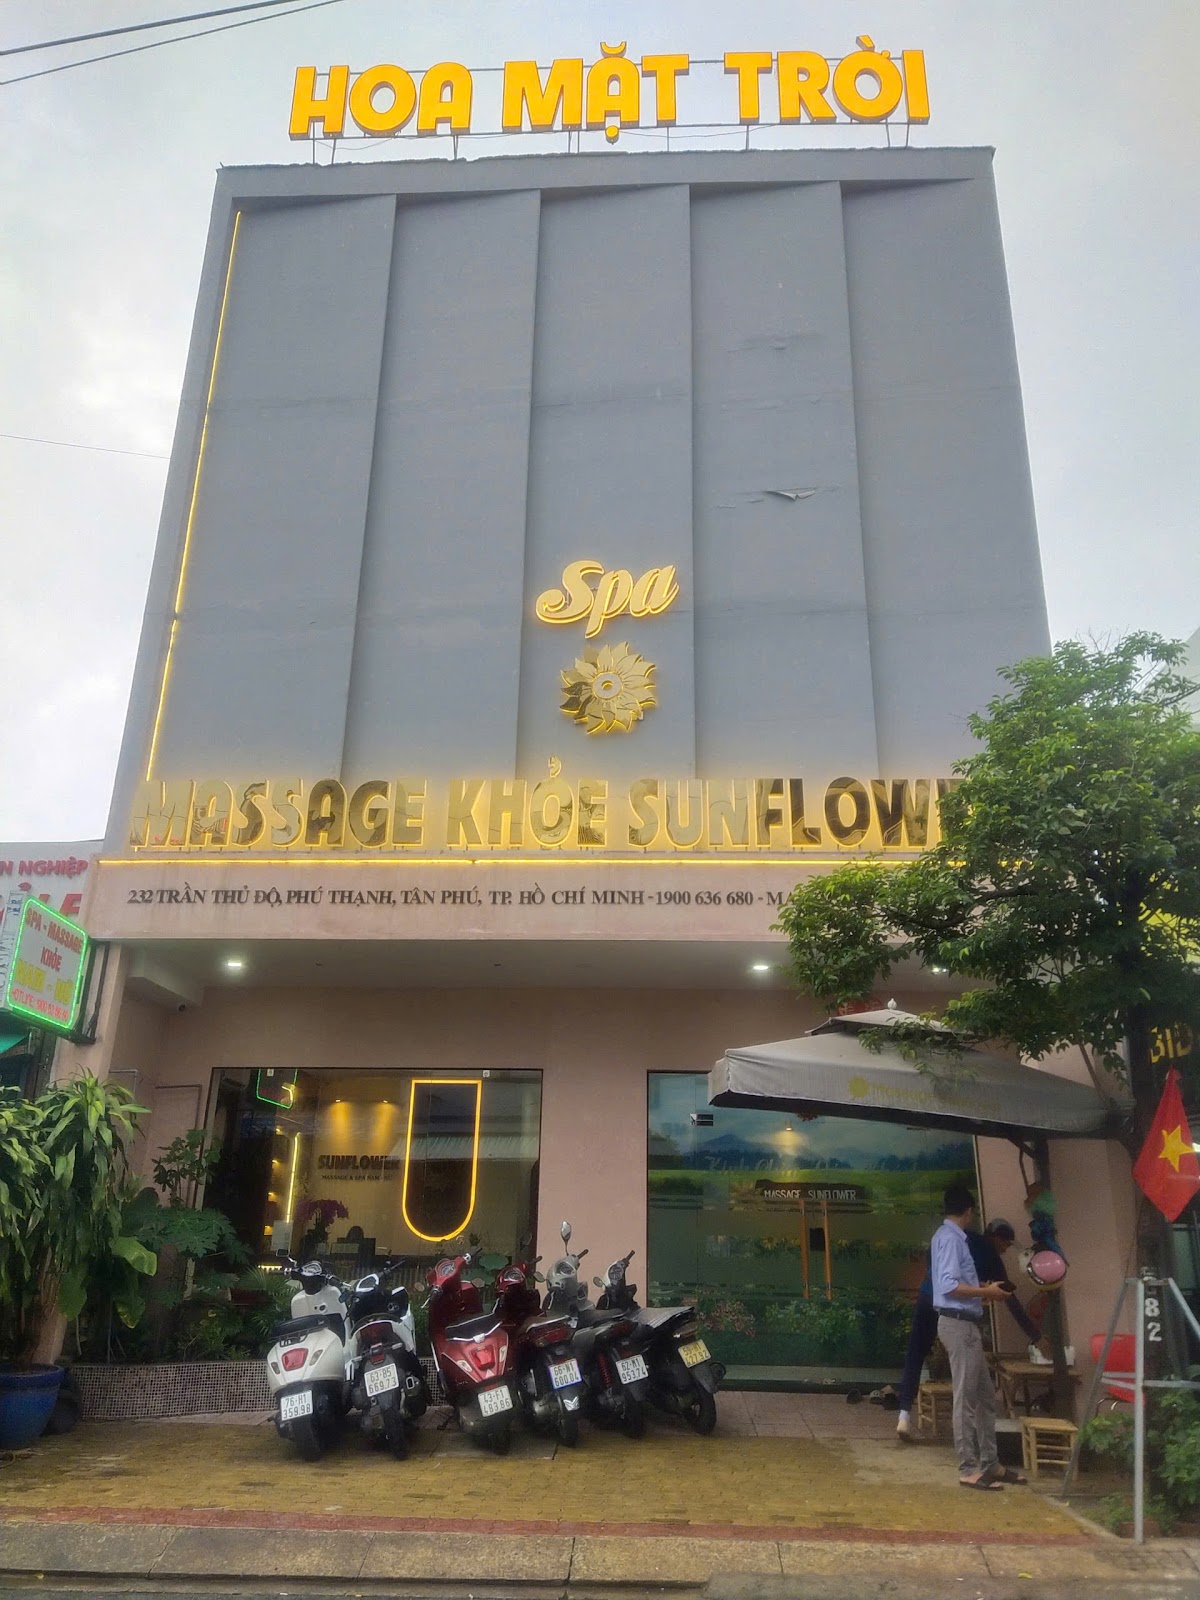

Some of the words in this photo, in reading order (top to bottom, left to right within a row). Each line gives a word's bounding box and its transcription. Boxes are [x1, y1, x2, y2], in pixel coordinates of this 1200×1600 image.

[289, 62, 472, 141] HOA
[502, 42, 690, 145] MẶT
[724, 35, 931, 125] TRỜI
[536, 560, 680, 638] Spa
[128, 778, 429, 848] MASSAGE
[447, 755, 609, 847] KHỎE
[18, 856, 88, 879] NGHIỆP
[126, 889, 154, 905] 232
[156, 881, 207, 905] TRẦN
[211, 885, 249, 905] THỦ
[253, 886, 283, 908] ĐỘ,
[286, 885, 323, 905] PHÚ
[328, 889, 397, 907] THẠNH,
[401, 886, 436, 905] TÂN
[440, 885, 482, 907] PHÚ,
[489, 889, 513, 906] TP.
[519, 882, 546, 906] HỒ
[551, 885, 586, 906] CHÍ
[592, 889, 645, 906] MINH
[694, 890, 722, 906] 636
[726, 890, 754, 906] 680
[318, 1154, 400, 1170] SUNFLOWER
[764, 1189, 801, 1199] MASSAGE
[808, 1189, 857, 1200] SUNFLOWER
[368, 1378, 398, 1394] 669.73
[283, 1403, 312, 1419] 359.98
